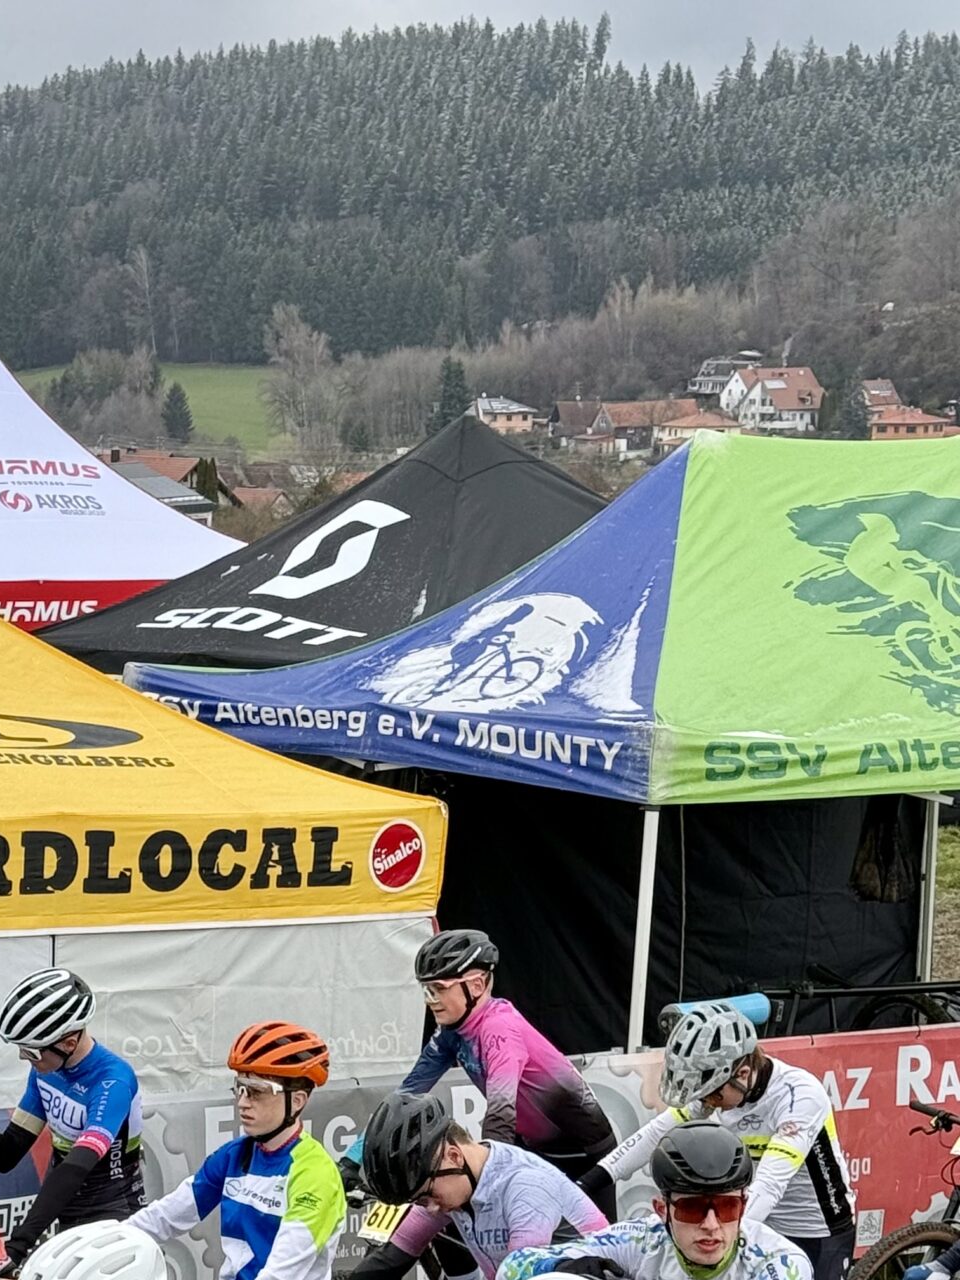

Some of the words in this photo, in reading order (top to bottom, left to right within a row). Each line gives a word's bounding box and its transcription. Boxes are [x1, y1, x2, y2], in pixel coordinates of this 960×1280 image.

[37, 493, 103, 510] AKROS
[136, 606, 367, 645] SCOTT
[214, 700, 366, 737] Altenberg
[377, 711, 441, 743] e.V.
[454, 719, 624, 770] MOUNTY
[704, 741, 827, 782] SSV
[373, 835, 420, 876] Sinalco
[367, 1204, 399, 1230] 611
[352, 1243, 365, 1258] Cup
